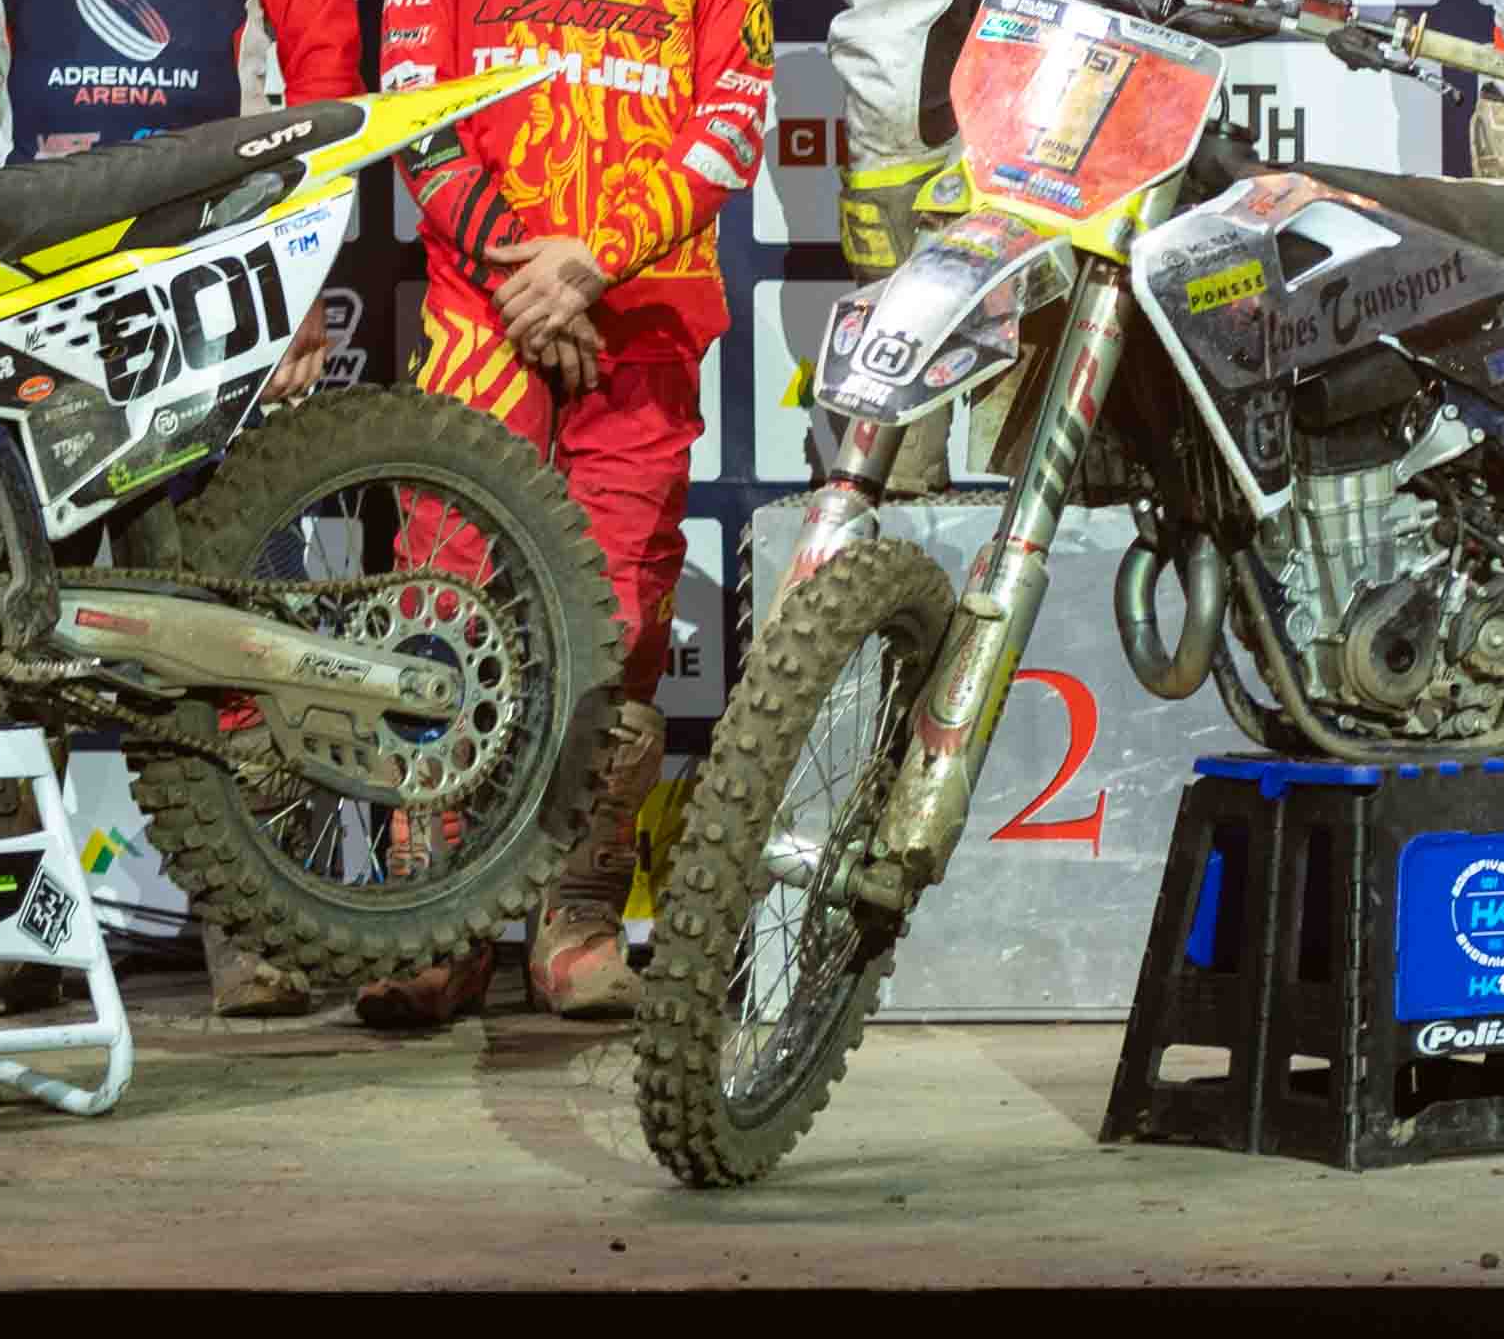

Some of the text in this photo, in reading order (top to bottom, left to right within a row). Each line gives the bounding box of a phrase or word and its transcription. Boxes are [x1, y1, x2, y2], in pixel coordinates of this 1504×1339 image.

[47, 65, 199, 89] ADRENALIN
[73, 86, 168, 106] ARENA
[586, 56, 672, 99] JCR
[237, 120, 313, 158] GUTS
[1319, 249, 1469, 346] Transport
[988, 667, 1109, 859] 2
